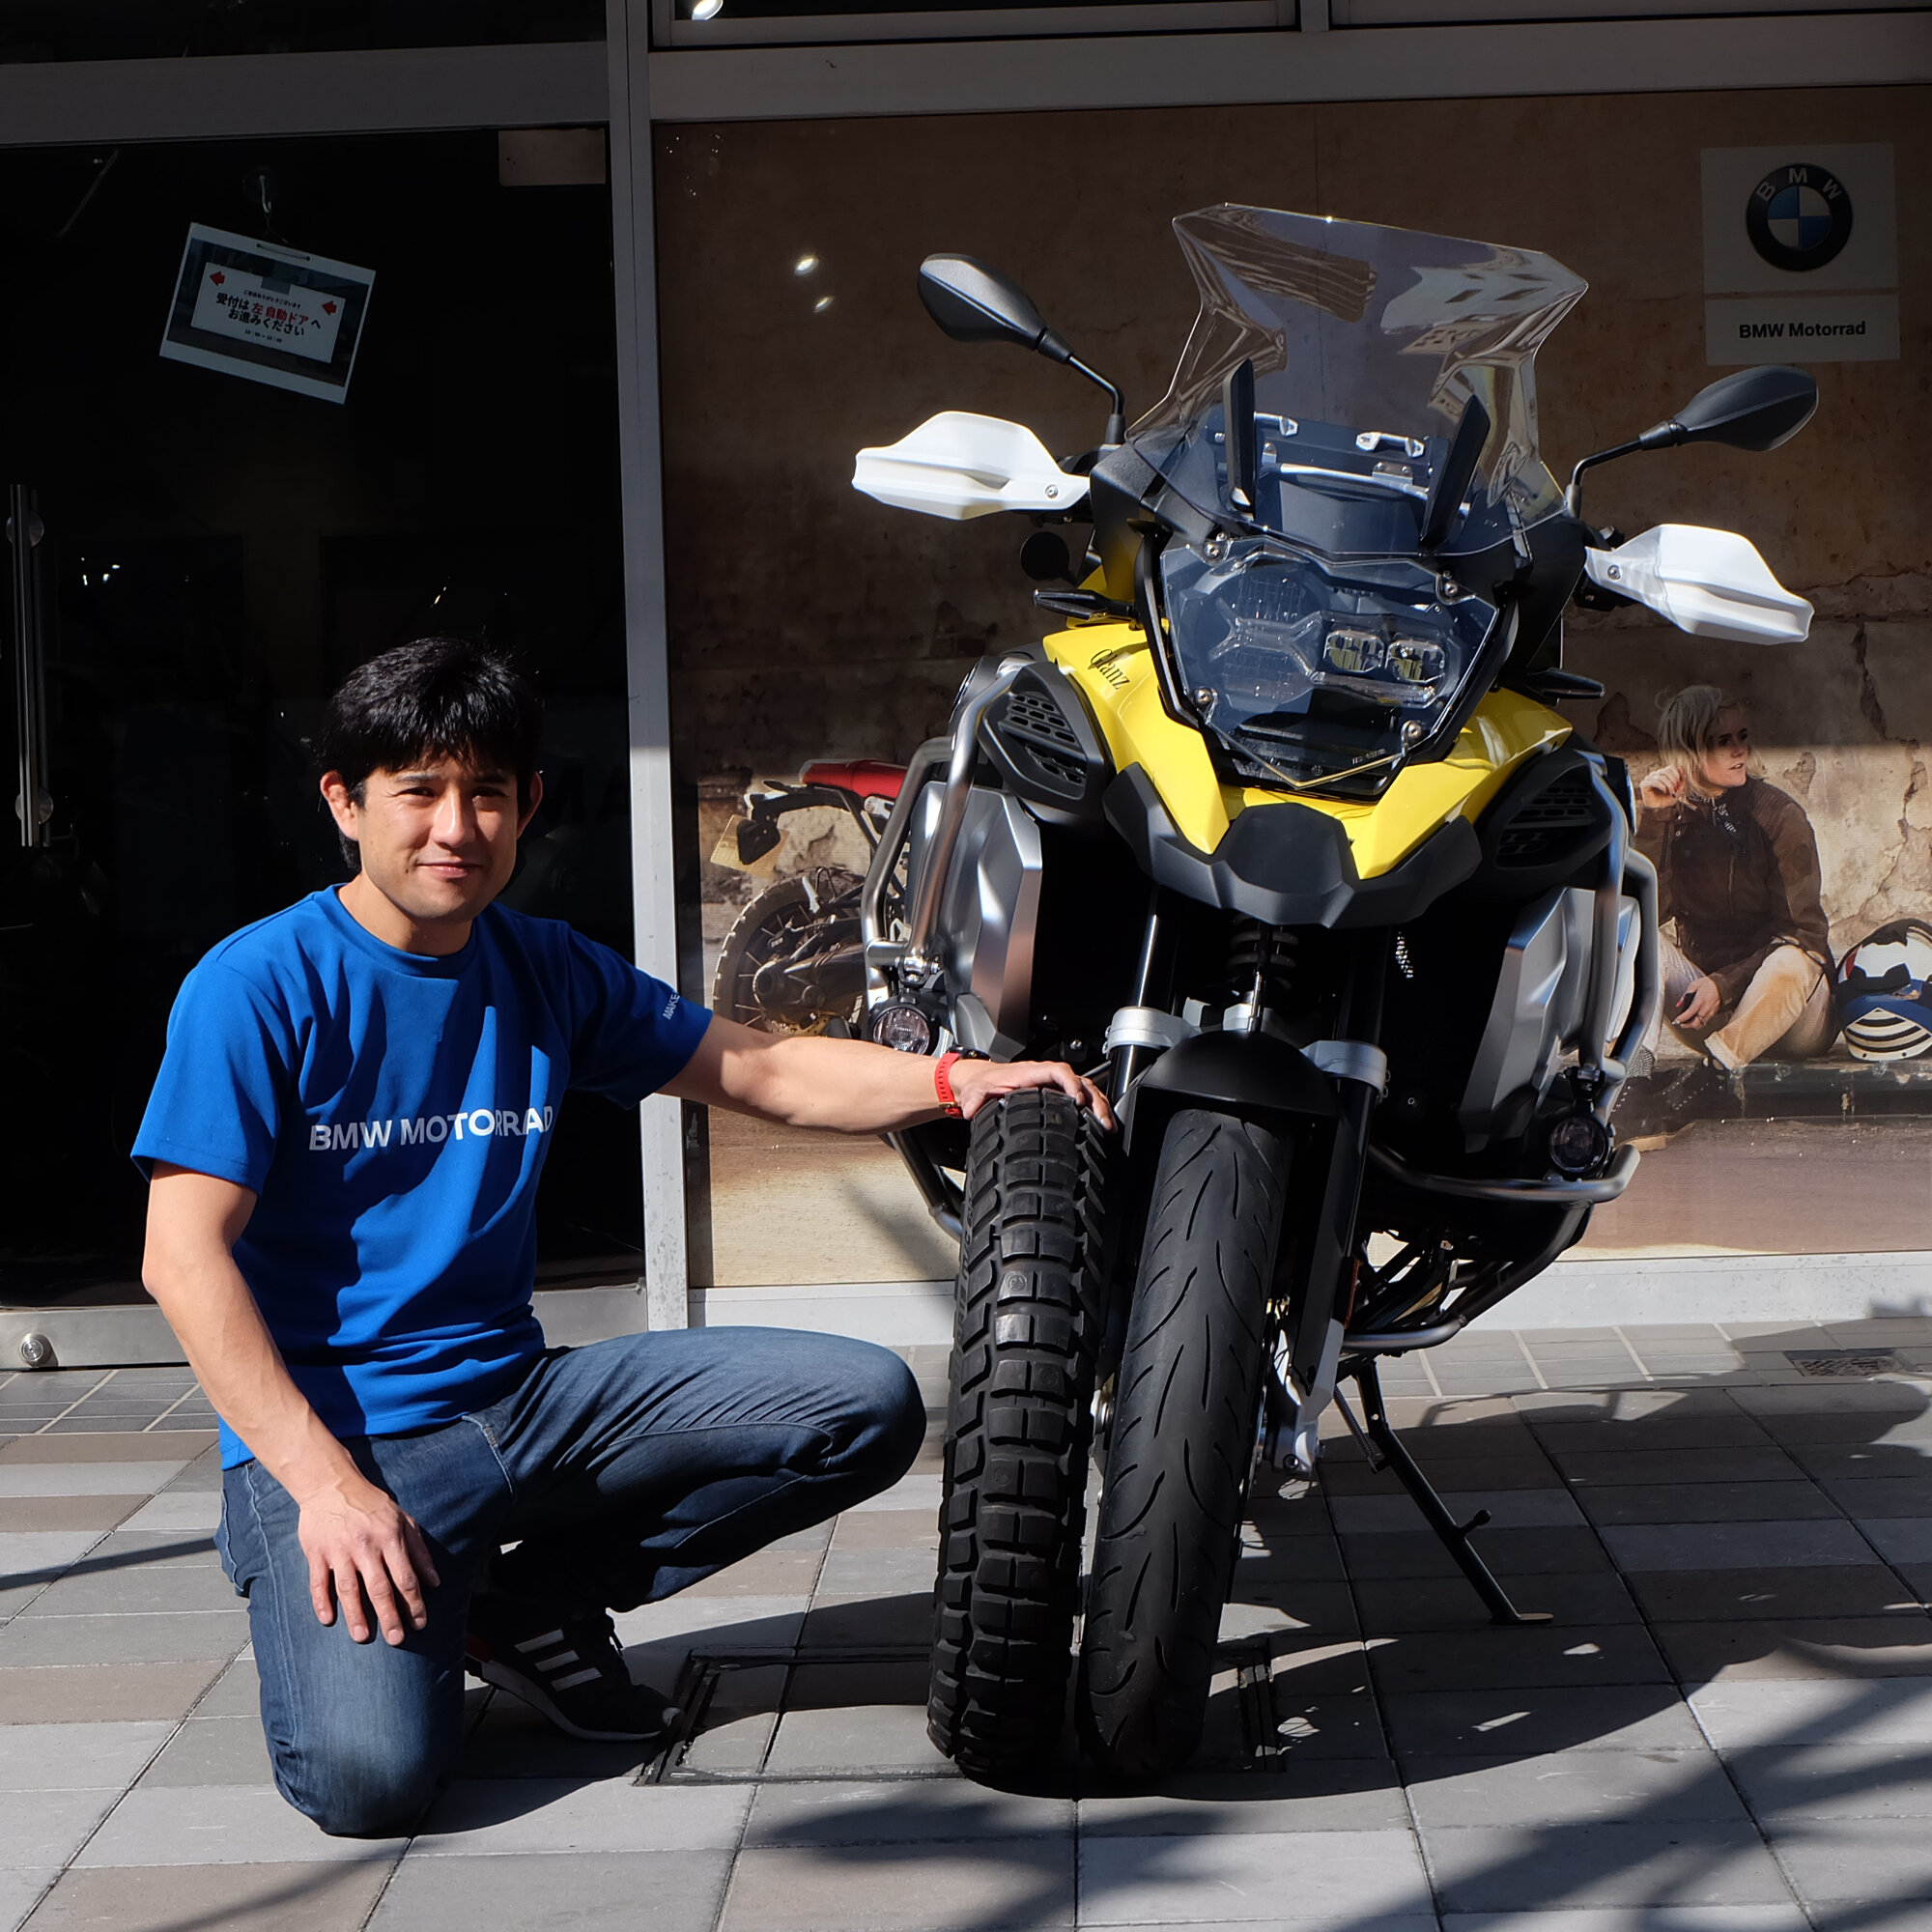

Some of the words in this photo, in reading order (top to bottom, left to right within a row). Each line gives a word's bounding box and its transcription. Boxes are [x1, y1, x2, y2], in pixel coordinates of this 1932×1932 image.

[1755, 167, 1843, 201] BMW
[216, 292, 249, 309] 受付は
[251, 302, 264, 314] 左
[266, 306, 309, 326] 自動ドア
[311, 319, 321, 329] へ
[228, 308, 305, 335] お進みください
[1739, 323, 1784, 339] BMW
[1788, 320, 1866, 337] Motorrad
[663, 993, 681, 1020] MAKE
[308, 1119, 393, 1151] BMW
[400, 1105, 554, 1147] MOTORRAD
